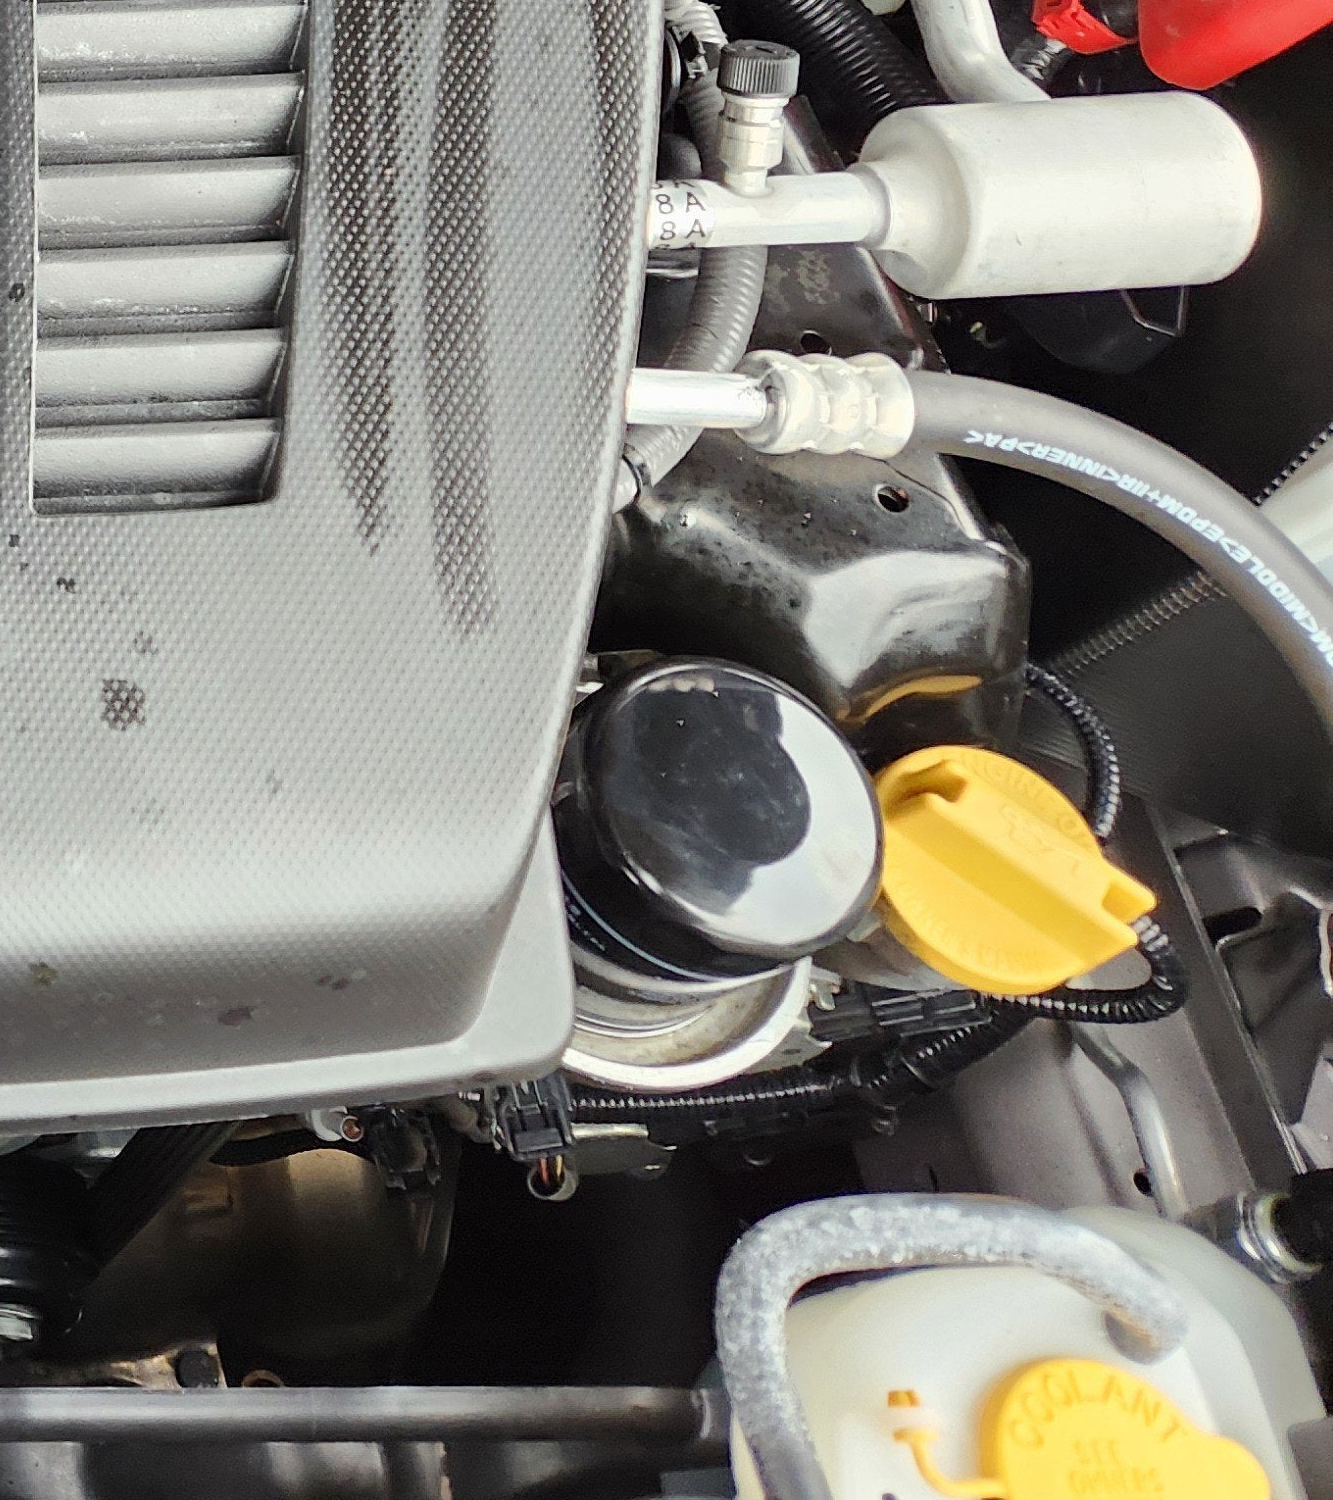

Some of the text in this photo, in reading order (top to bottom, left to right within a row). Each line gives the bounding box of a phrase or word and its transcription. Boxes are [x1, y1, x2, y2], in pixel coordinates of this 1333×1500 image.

[685, 190, 707, 213] A
[684, 218, 707, 239] A
[1007, 1368, 1186, 1448] COOLANT
